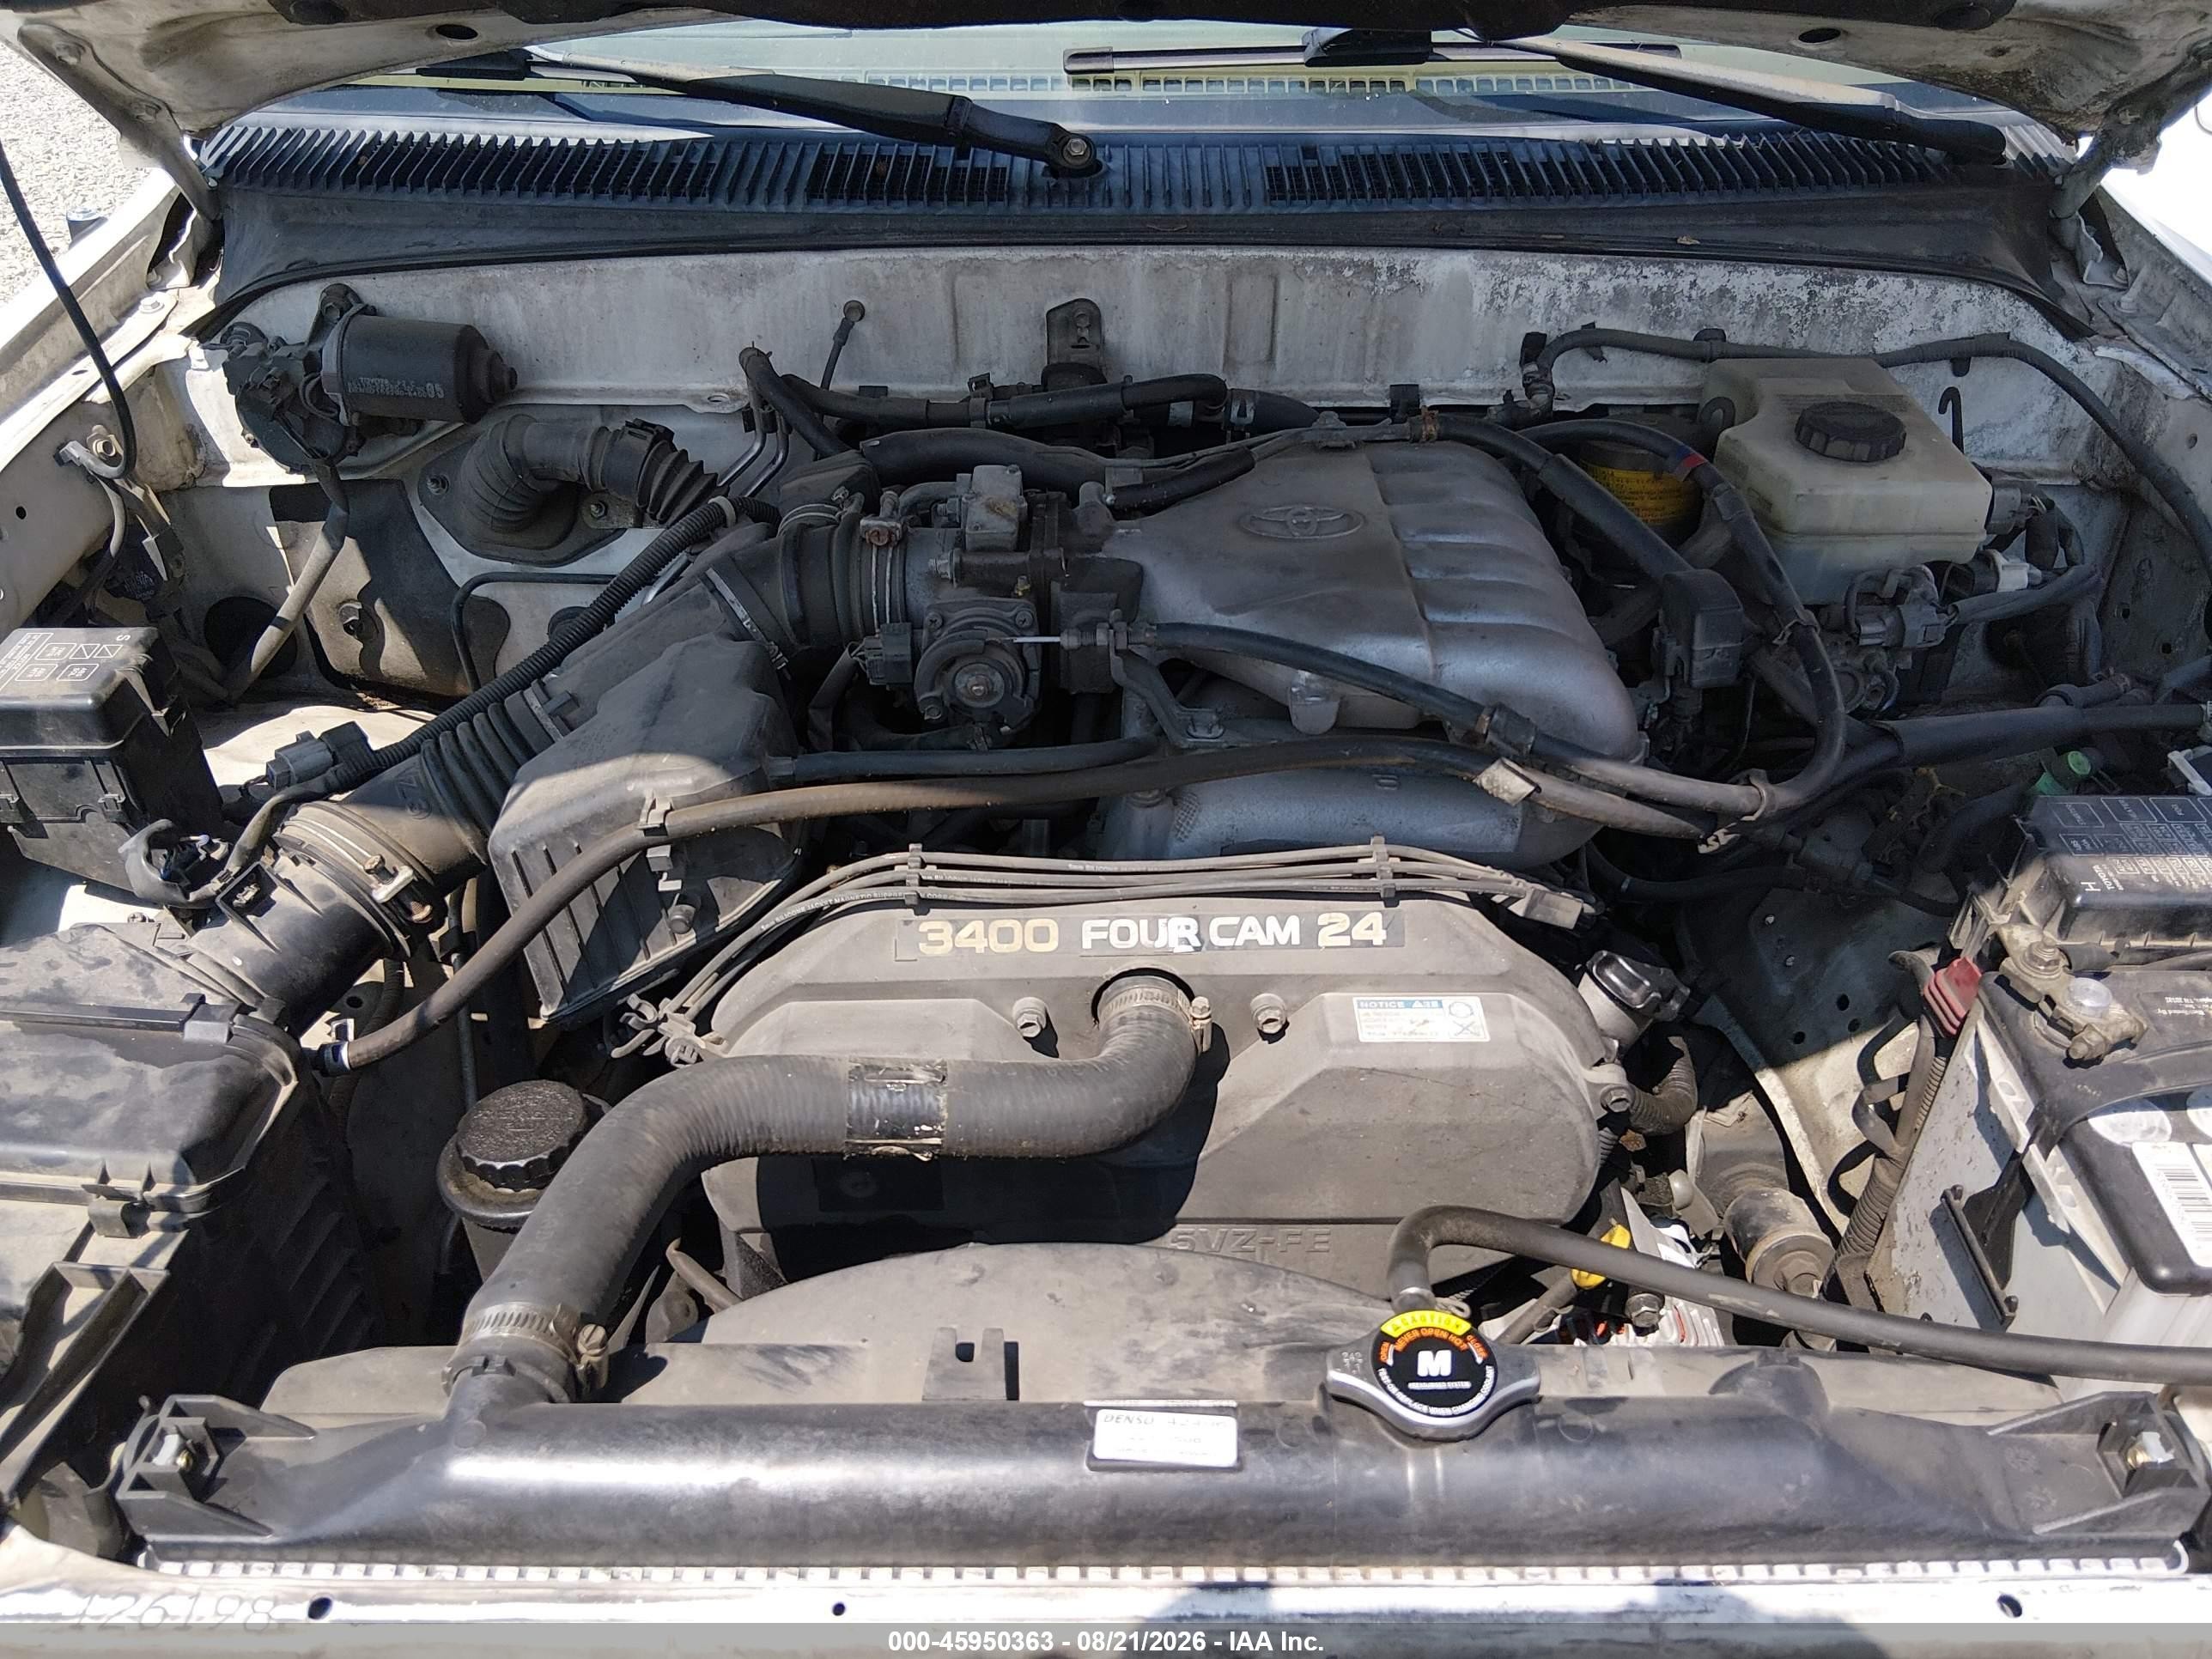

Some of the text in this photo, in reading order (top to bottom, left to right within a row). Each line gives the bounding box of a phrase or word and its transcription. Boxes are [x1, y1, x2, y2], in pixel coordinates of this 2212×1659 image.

[2081, 882, 2101, 892] H
[2092, 864, 2116, 890] TOYOTA
[918, 911, 1388, 954] 3400 FOUR CAM 24
[1170, 1227, 1332, 1254] 5VZ-FE
[1401, 1313, 1462, 1330] CAUTION
[1394, 1328, 1469, 1352] NEVER OPEN HOT
[1417, 1349, 1452, 1377] M
[1103, 1413, 1155, 1425] DENSO
